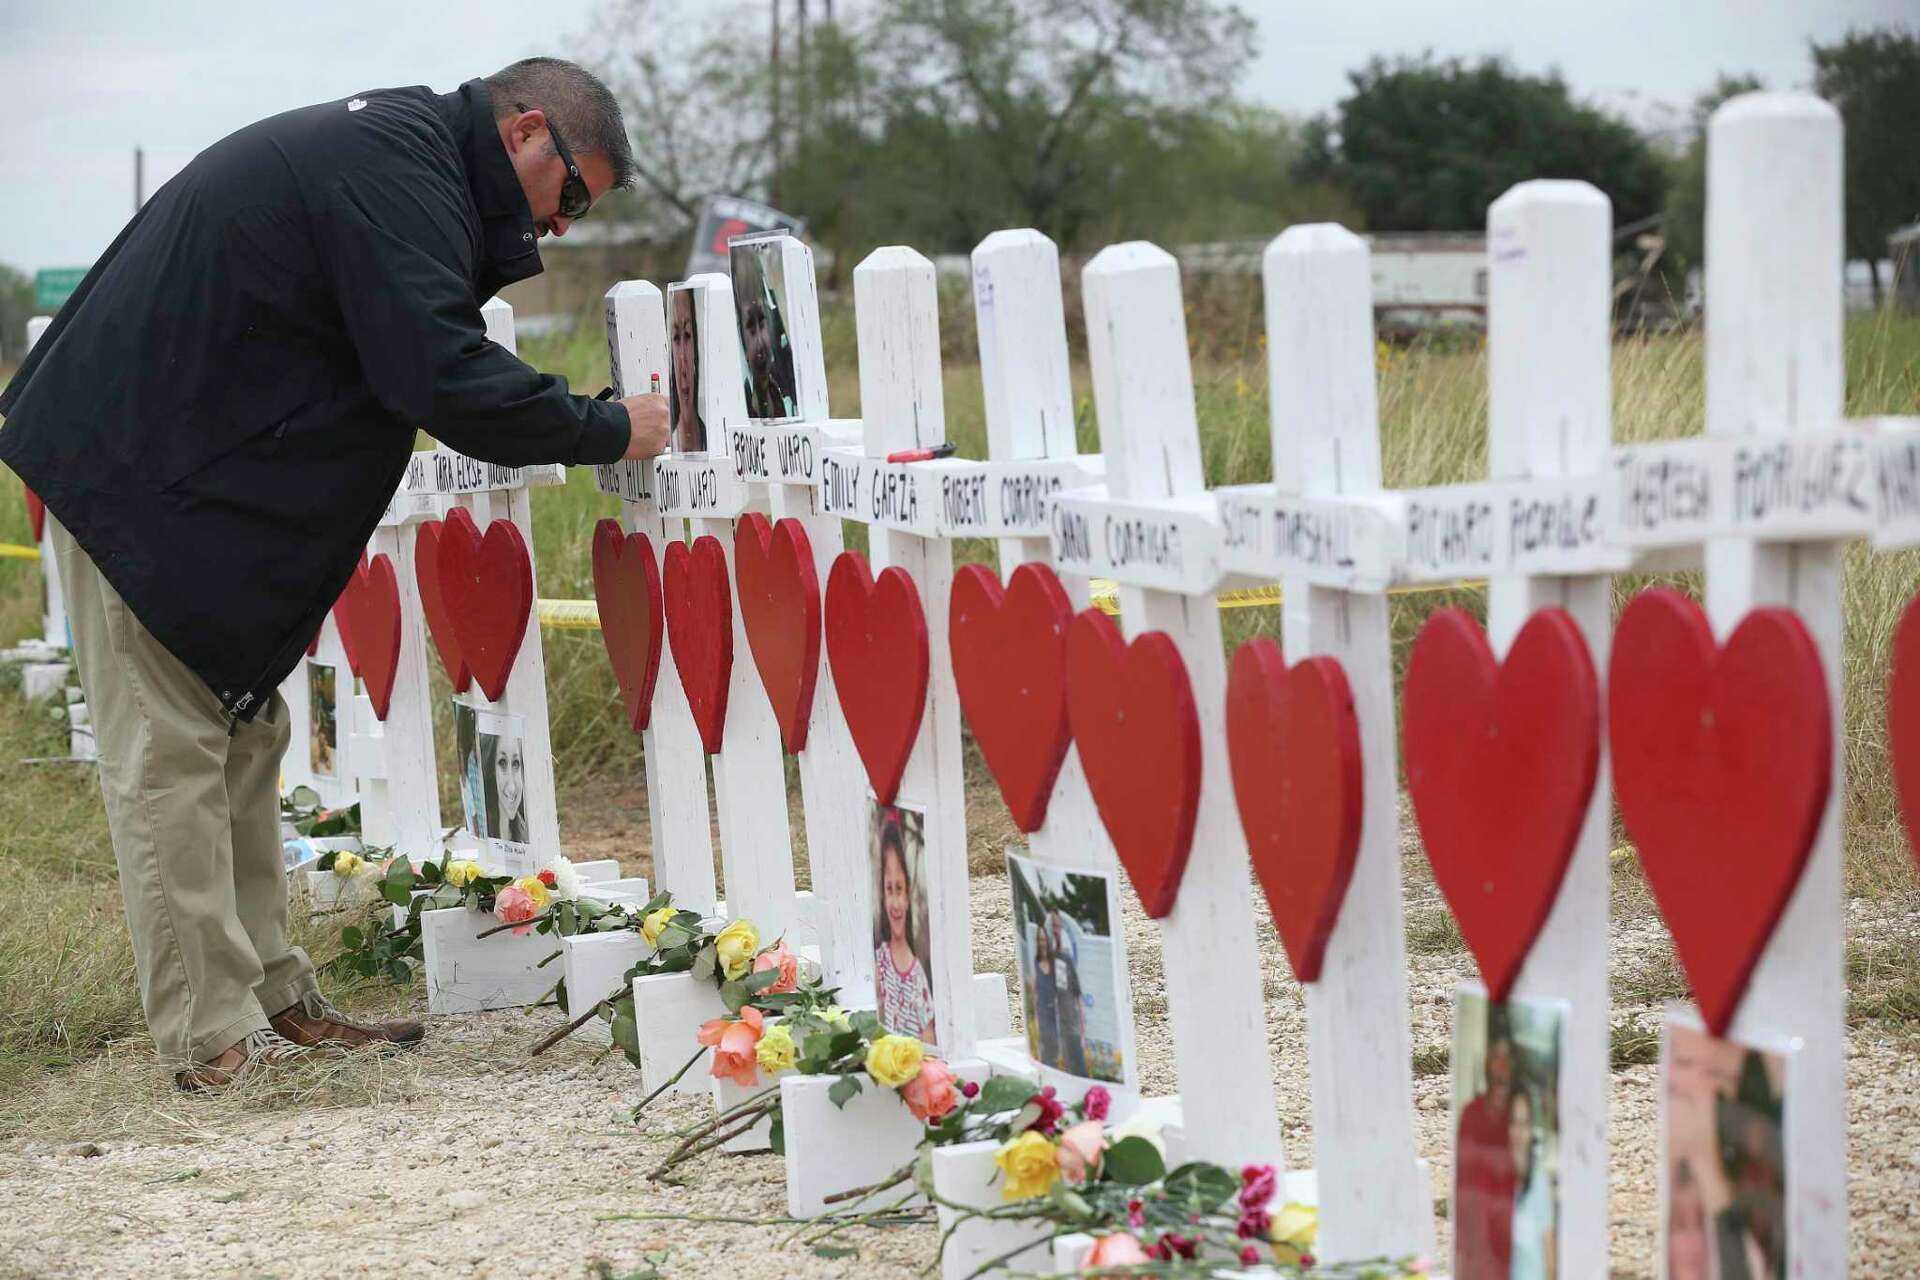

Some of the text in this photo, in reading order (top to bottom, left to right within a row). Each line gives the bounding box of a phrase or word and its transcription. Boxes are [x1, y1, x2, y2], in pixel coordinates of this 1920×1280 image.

[433, 453, 454, 493] TARA
[456, 454, 482, 490] ELYSE
[733, 431, 813, 480] BROOKE WARD
[626, 458, 651, 499] HILL
[688, 468, 717, 510] WARD
[822, 457, 918, 526] EMILY GARZA
[942, 473, 988, 529] ROBERT
